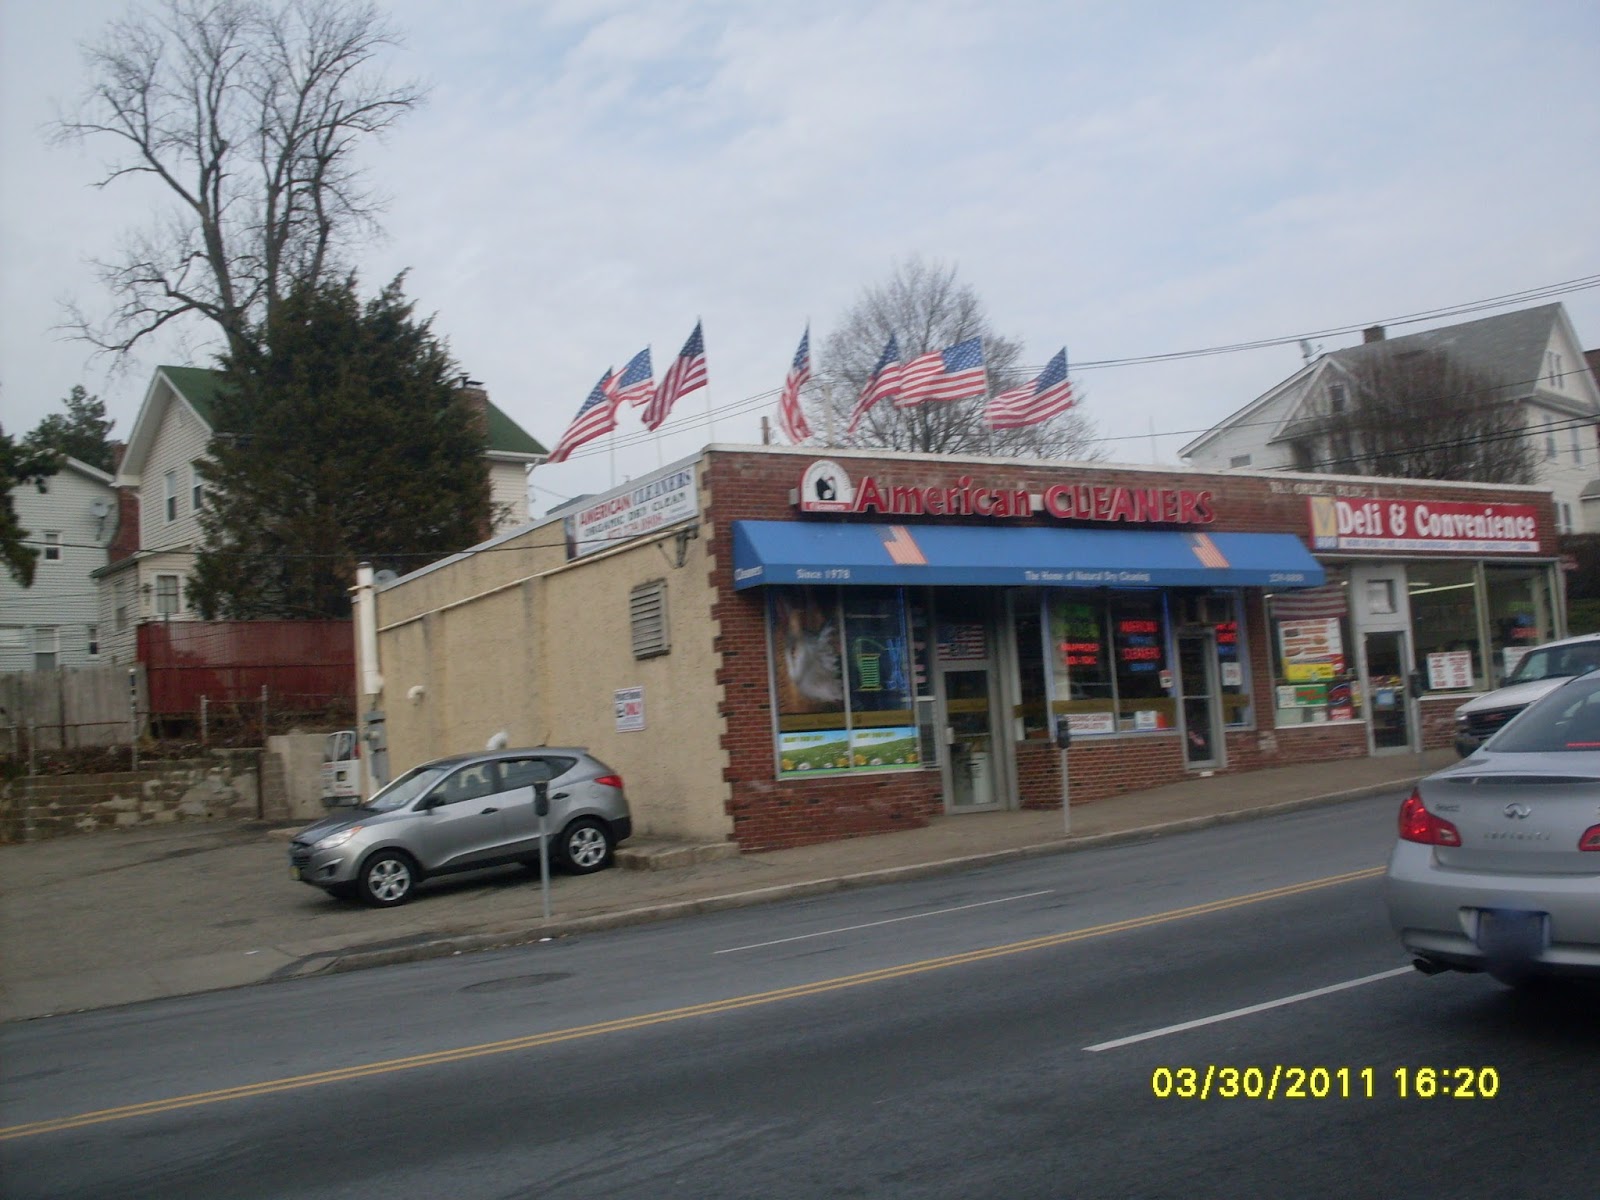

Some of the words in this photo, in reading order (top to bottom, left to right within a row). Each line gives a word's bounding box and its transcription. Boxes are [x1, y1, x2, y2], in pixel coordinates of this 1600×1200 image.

[853, 475, 1033, 517] American
[1044, 485, 1217, 524] CLEANERS
[1337, 502, 1383, 535] Deli
[1389, 504, 1407, 536] &
[1414, 505, 1536, 539] Convenience
[796, 569, 822, 579] Since
[1025, 570, 1039, 581] The
